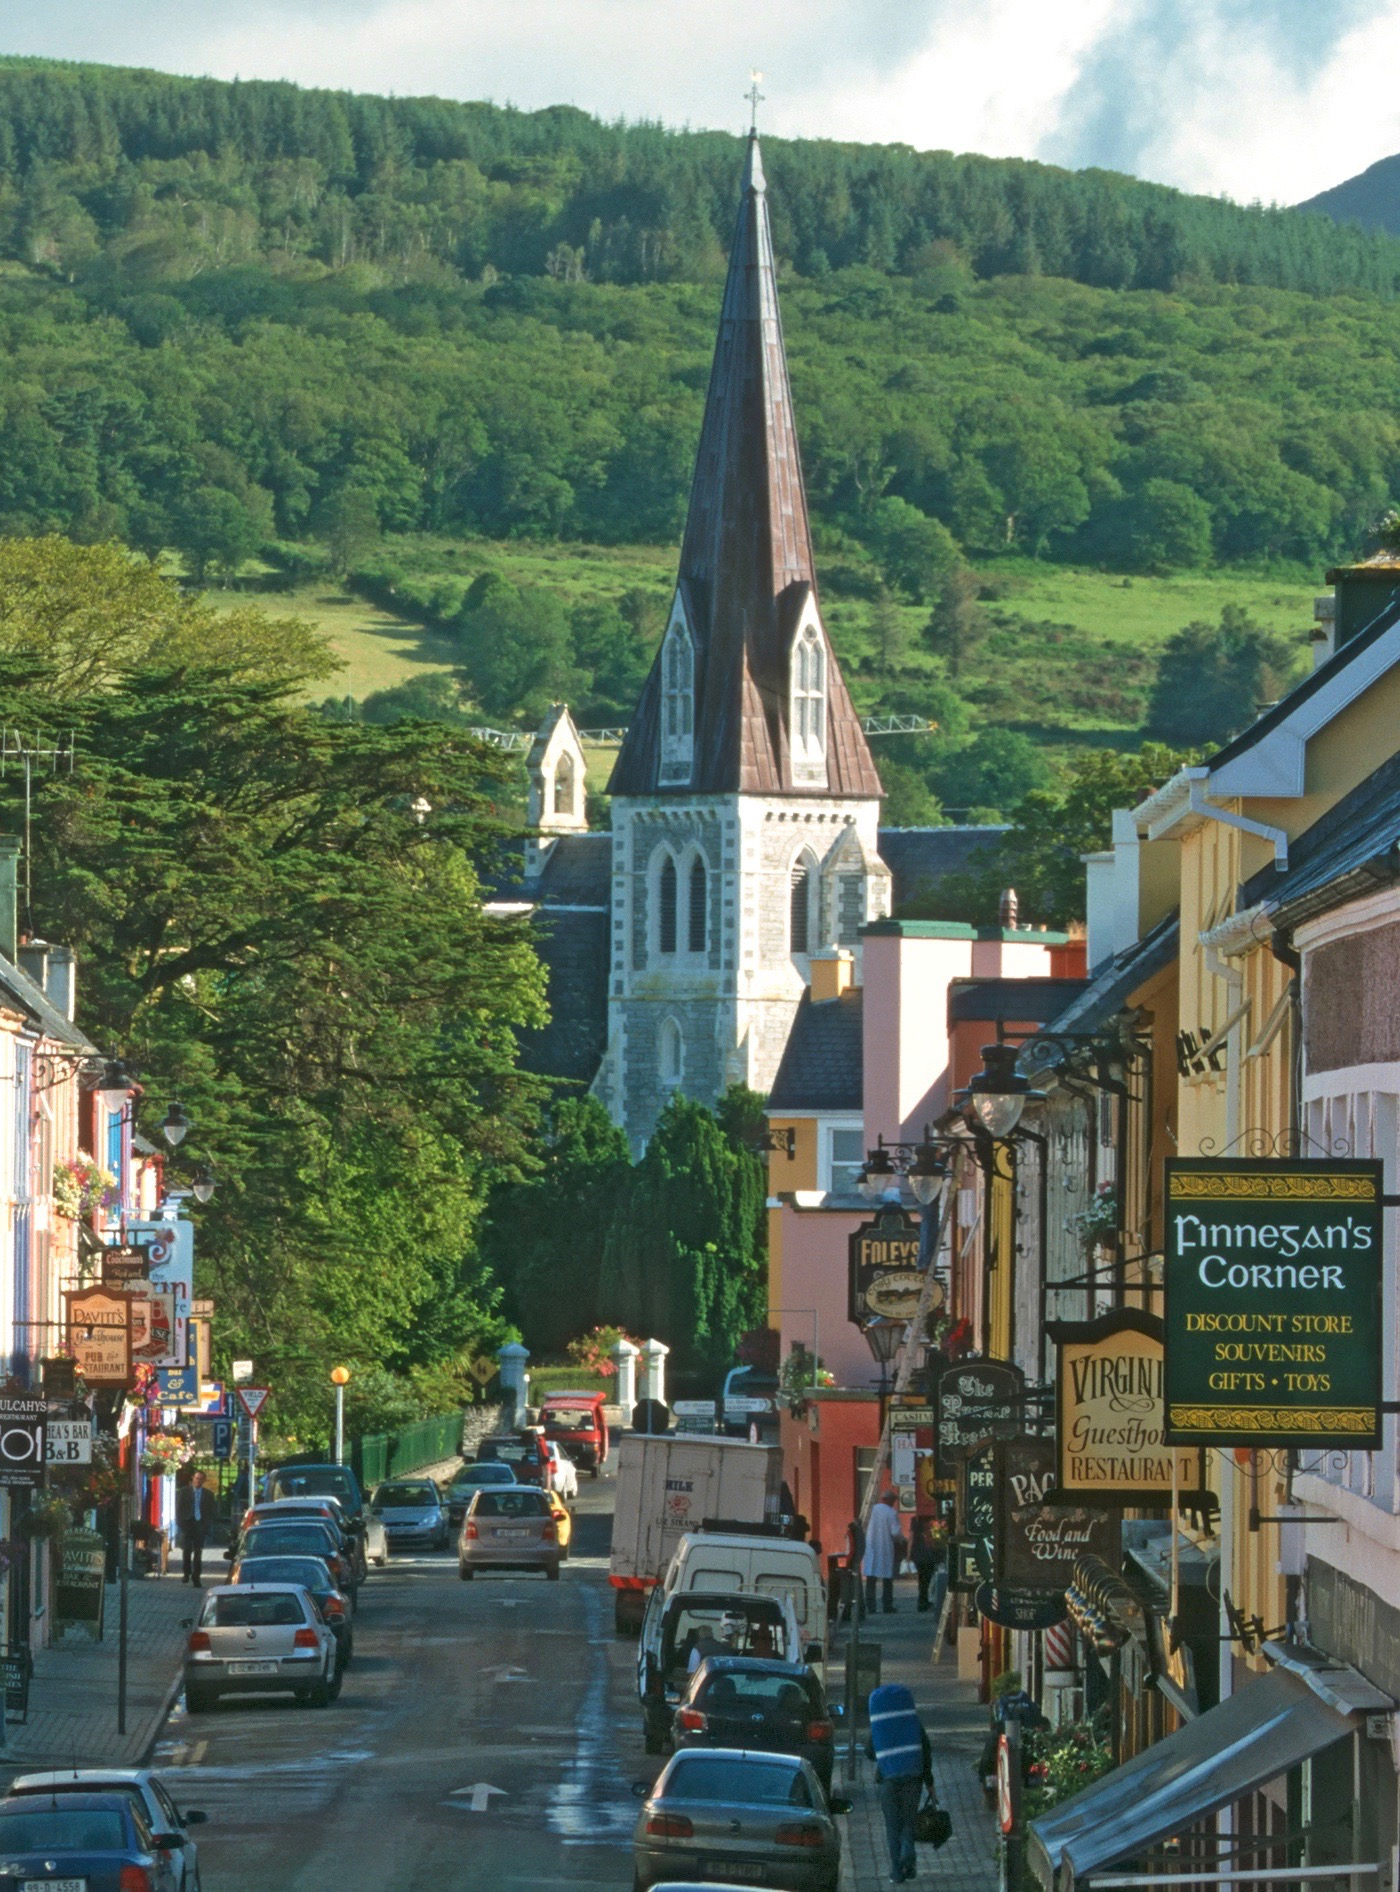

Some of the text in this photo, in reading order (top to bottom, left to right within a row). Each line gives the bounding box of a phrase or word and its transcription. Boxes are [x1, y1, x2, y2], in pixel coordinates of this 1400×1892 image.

[1174, 1214, 1372, 1257] Finnegan's
[1199, 1255, 1345, 1289] Corner
[73, 1308, 124, 1324] DAVITT'S
[1186, 1313, 1353, 1334] DISCOUNT STORE
[85, 1351, 103, 1363] PUB
[1215, 1343, 1326, 1363] SOUVENIRS
[959, 1376, 994, 1397] The
[1209, 1372, 1331, 1391] GIFTS TOYS
[156, 1391, 194, 1400] Cafe
[894, 1413, 933, 1423] CASHM
[72, 1425, 89, 1439] BAR
[1067, 1415, 1165, 1453] Guestho
[1025, 1517, 1097, 1544] Food and
[1031, 1542, 1079, 1561] Wine
